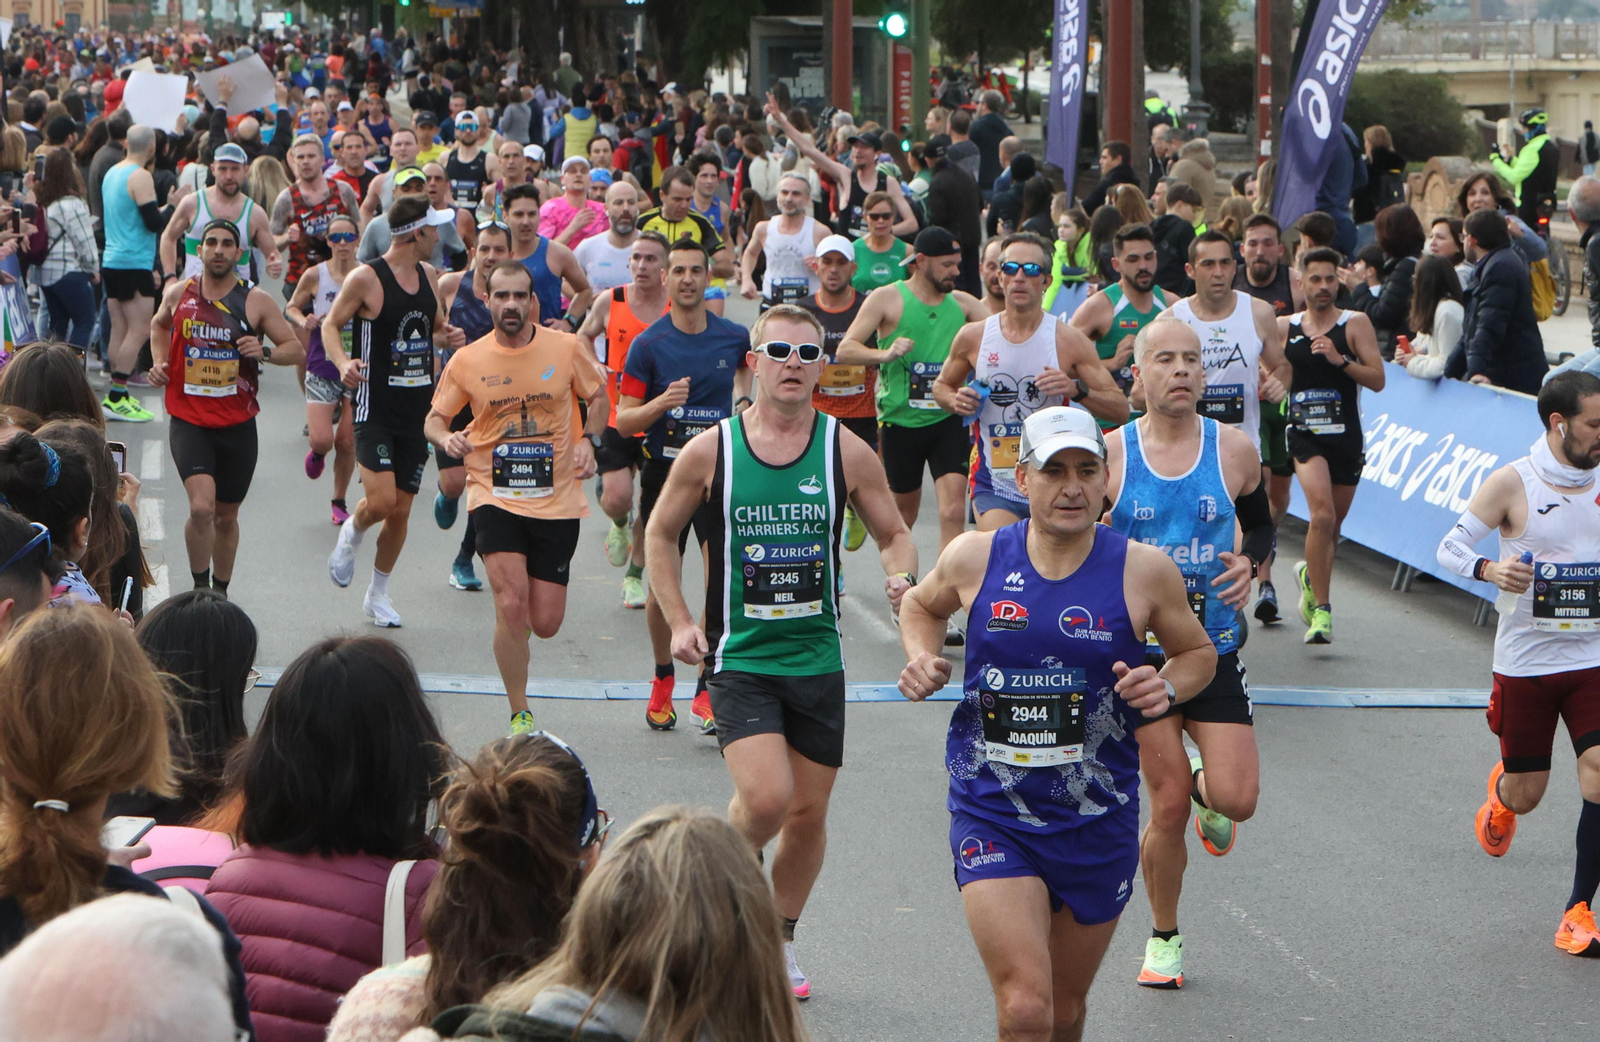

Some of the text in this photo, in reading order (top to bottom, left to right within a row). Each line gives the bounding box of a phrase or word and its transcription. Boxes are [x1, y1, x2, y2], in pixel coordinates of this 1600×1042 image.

[1316, 0, 1372, 87] asic
[203, 350, 233, 359] ZURICH
[1207, 388, 1238, 396] ZURICH
[1308, 391, 1335, 399] ZURICH
[490, 397, 520, 407] Maratón
[1206, 403, 1226, 412] 3496
[688, 409, 722, 419] ZURICH
[512, 446, 546, 455] ZURICH
[512, 464, 533, 474] 2494
[509, 478, 537, 487] DAMIÁN
[735, 503, 826, 523] CHILTERN
[737, 522, 824, 537] HARRIERS A.C.
[771, 546, 817, 558] ZURICH
[1562, 567, 1600, 577] ZURICH
[770, 572, 800, 585] 2345
[1003, 585, 1024, 593] mobel
[774, 592, 796, 603] NEIL
[1560, 589, 1586, 601] 3156
[1555, 607, 1590, 617] MITREIN
[1090, 634, 1112, 642] BENITO
[1011, 674, 1072, 688] ZURICH
[1011, 706, 1048, 722] 2944
[1007, 729, 1057, 746] JOAQUÍN
